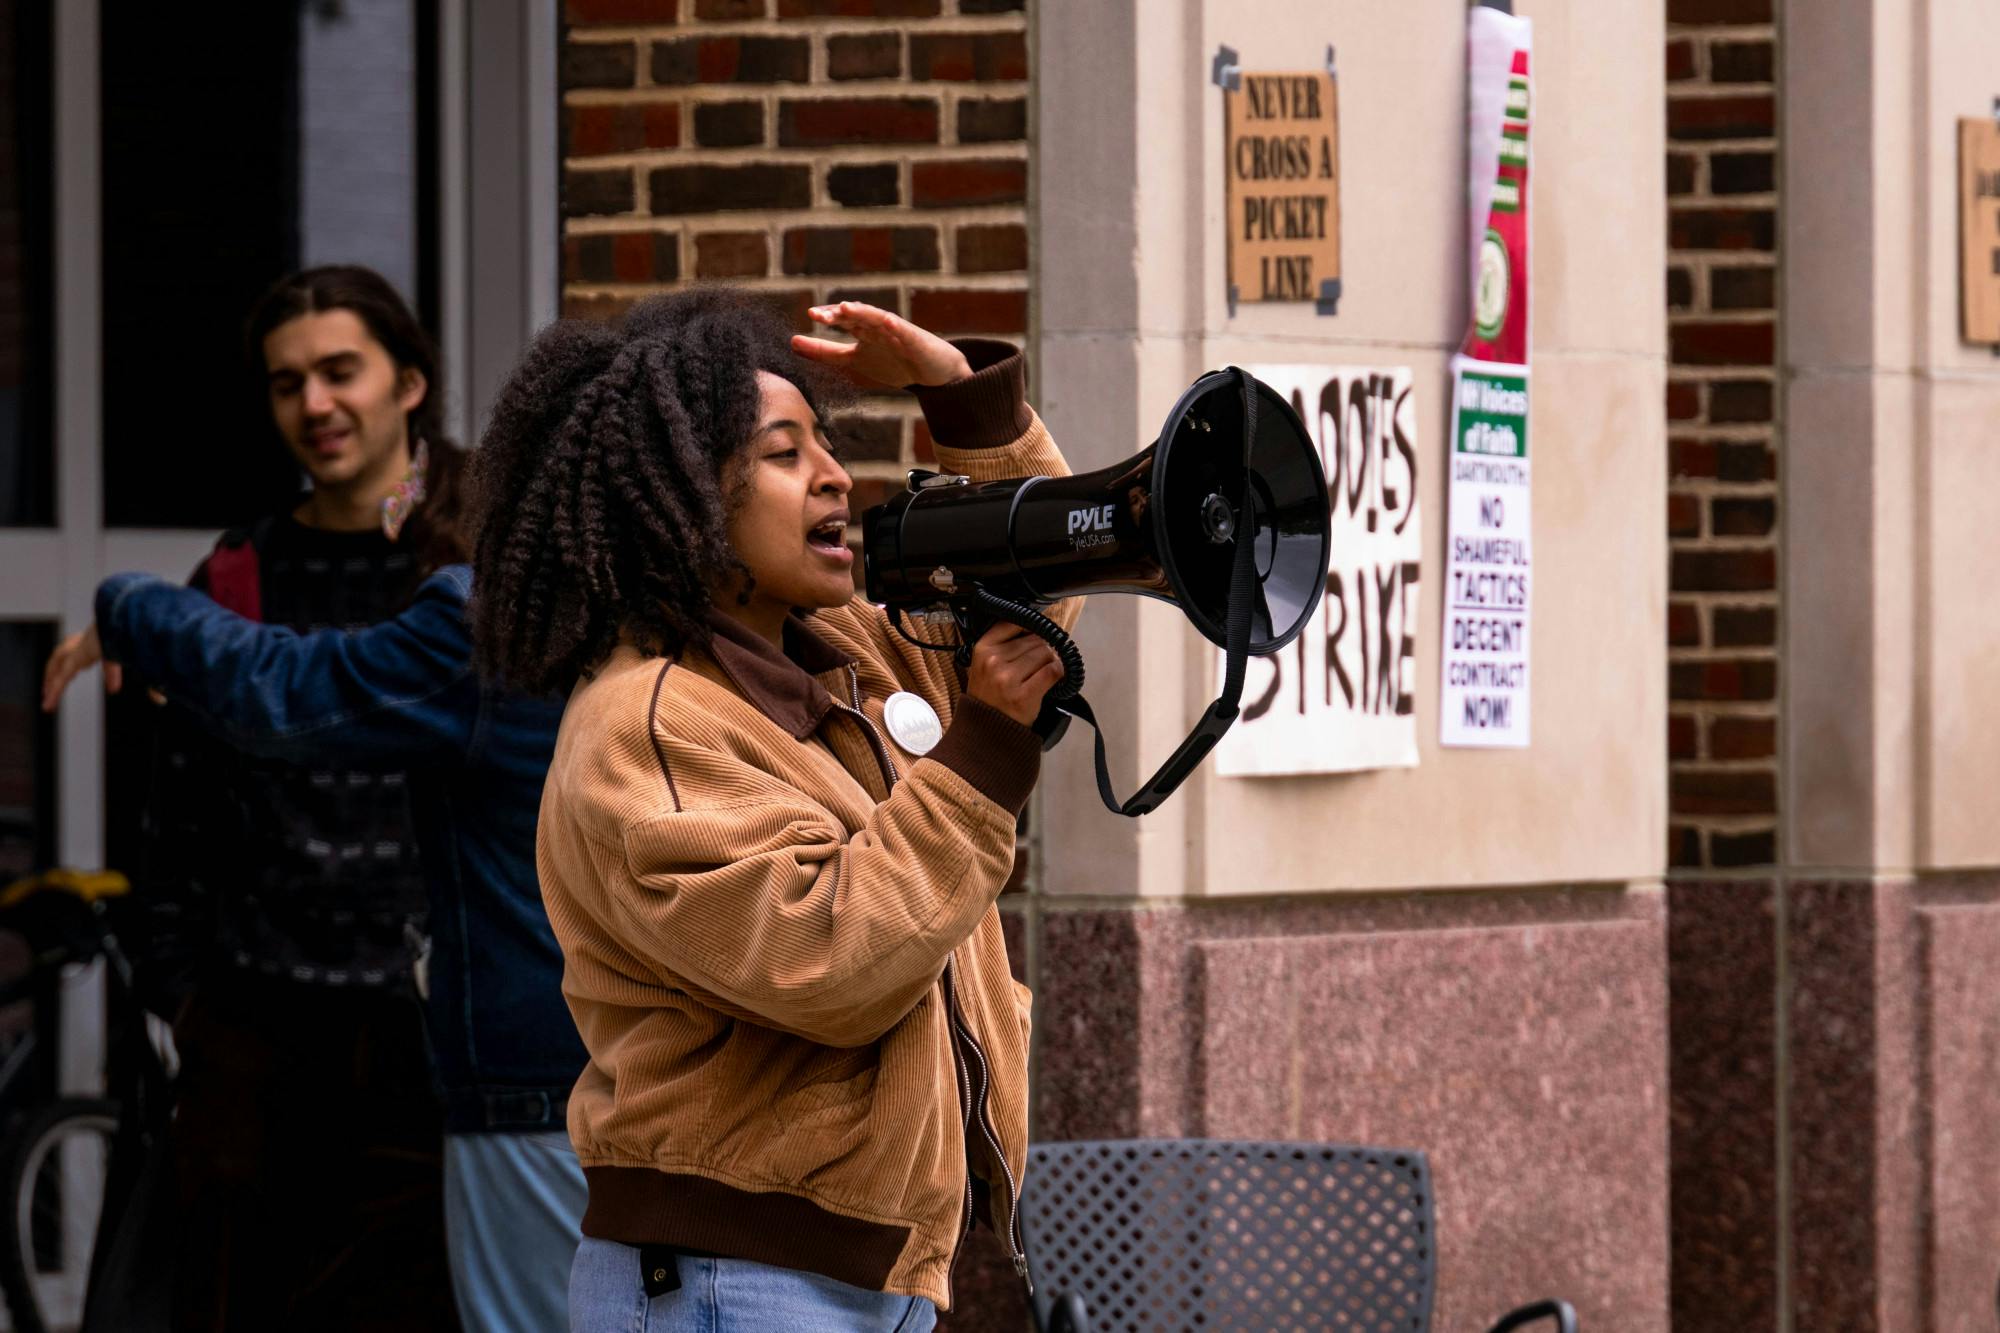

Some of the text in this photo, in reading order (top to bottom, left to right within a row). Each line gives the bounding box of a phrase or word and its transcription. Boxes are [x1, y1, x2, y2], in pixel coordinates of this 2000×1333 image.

[1245, 76, 1321, 120] NEVER
[1236, 135, 1333, 180] CROSS A
[1244, 196, 1327, 240] PICKET
[1261, 256, 1313, 300] LINE
[1067, 504, 1115, 534] PYLE
[1480, 497, 1504, 528] NO
[1455, 536, 1528, 565] SHAMEFUL
[1455, 572, 1527, 605] TACTICS
[1453, 617, 1523, 651] DECENT
[1450, 662, 1525, 688] CONTRACT
